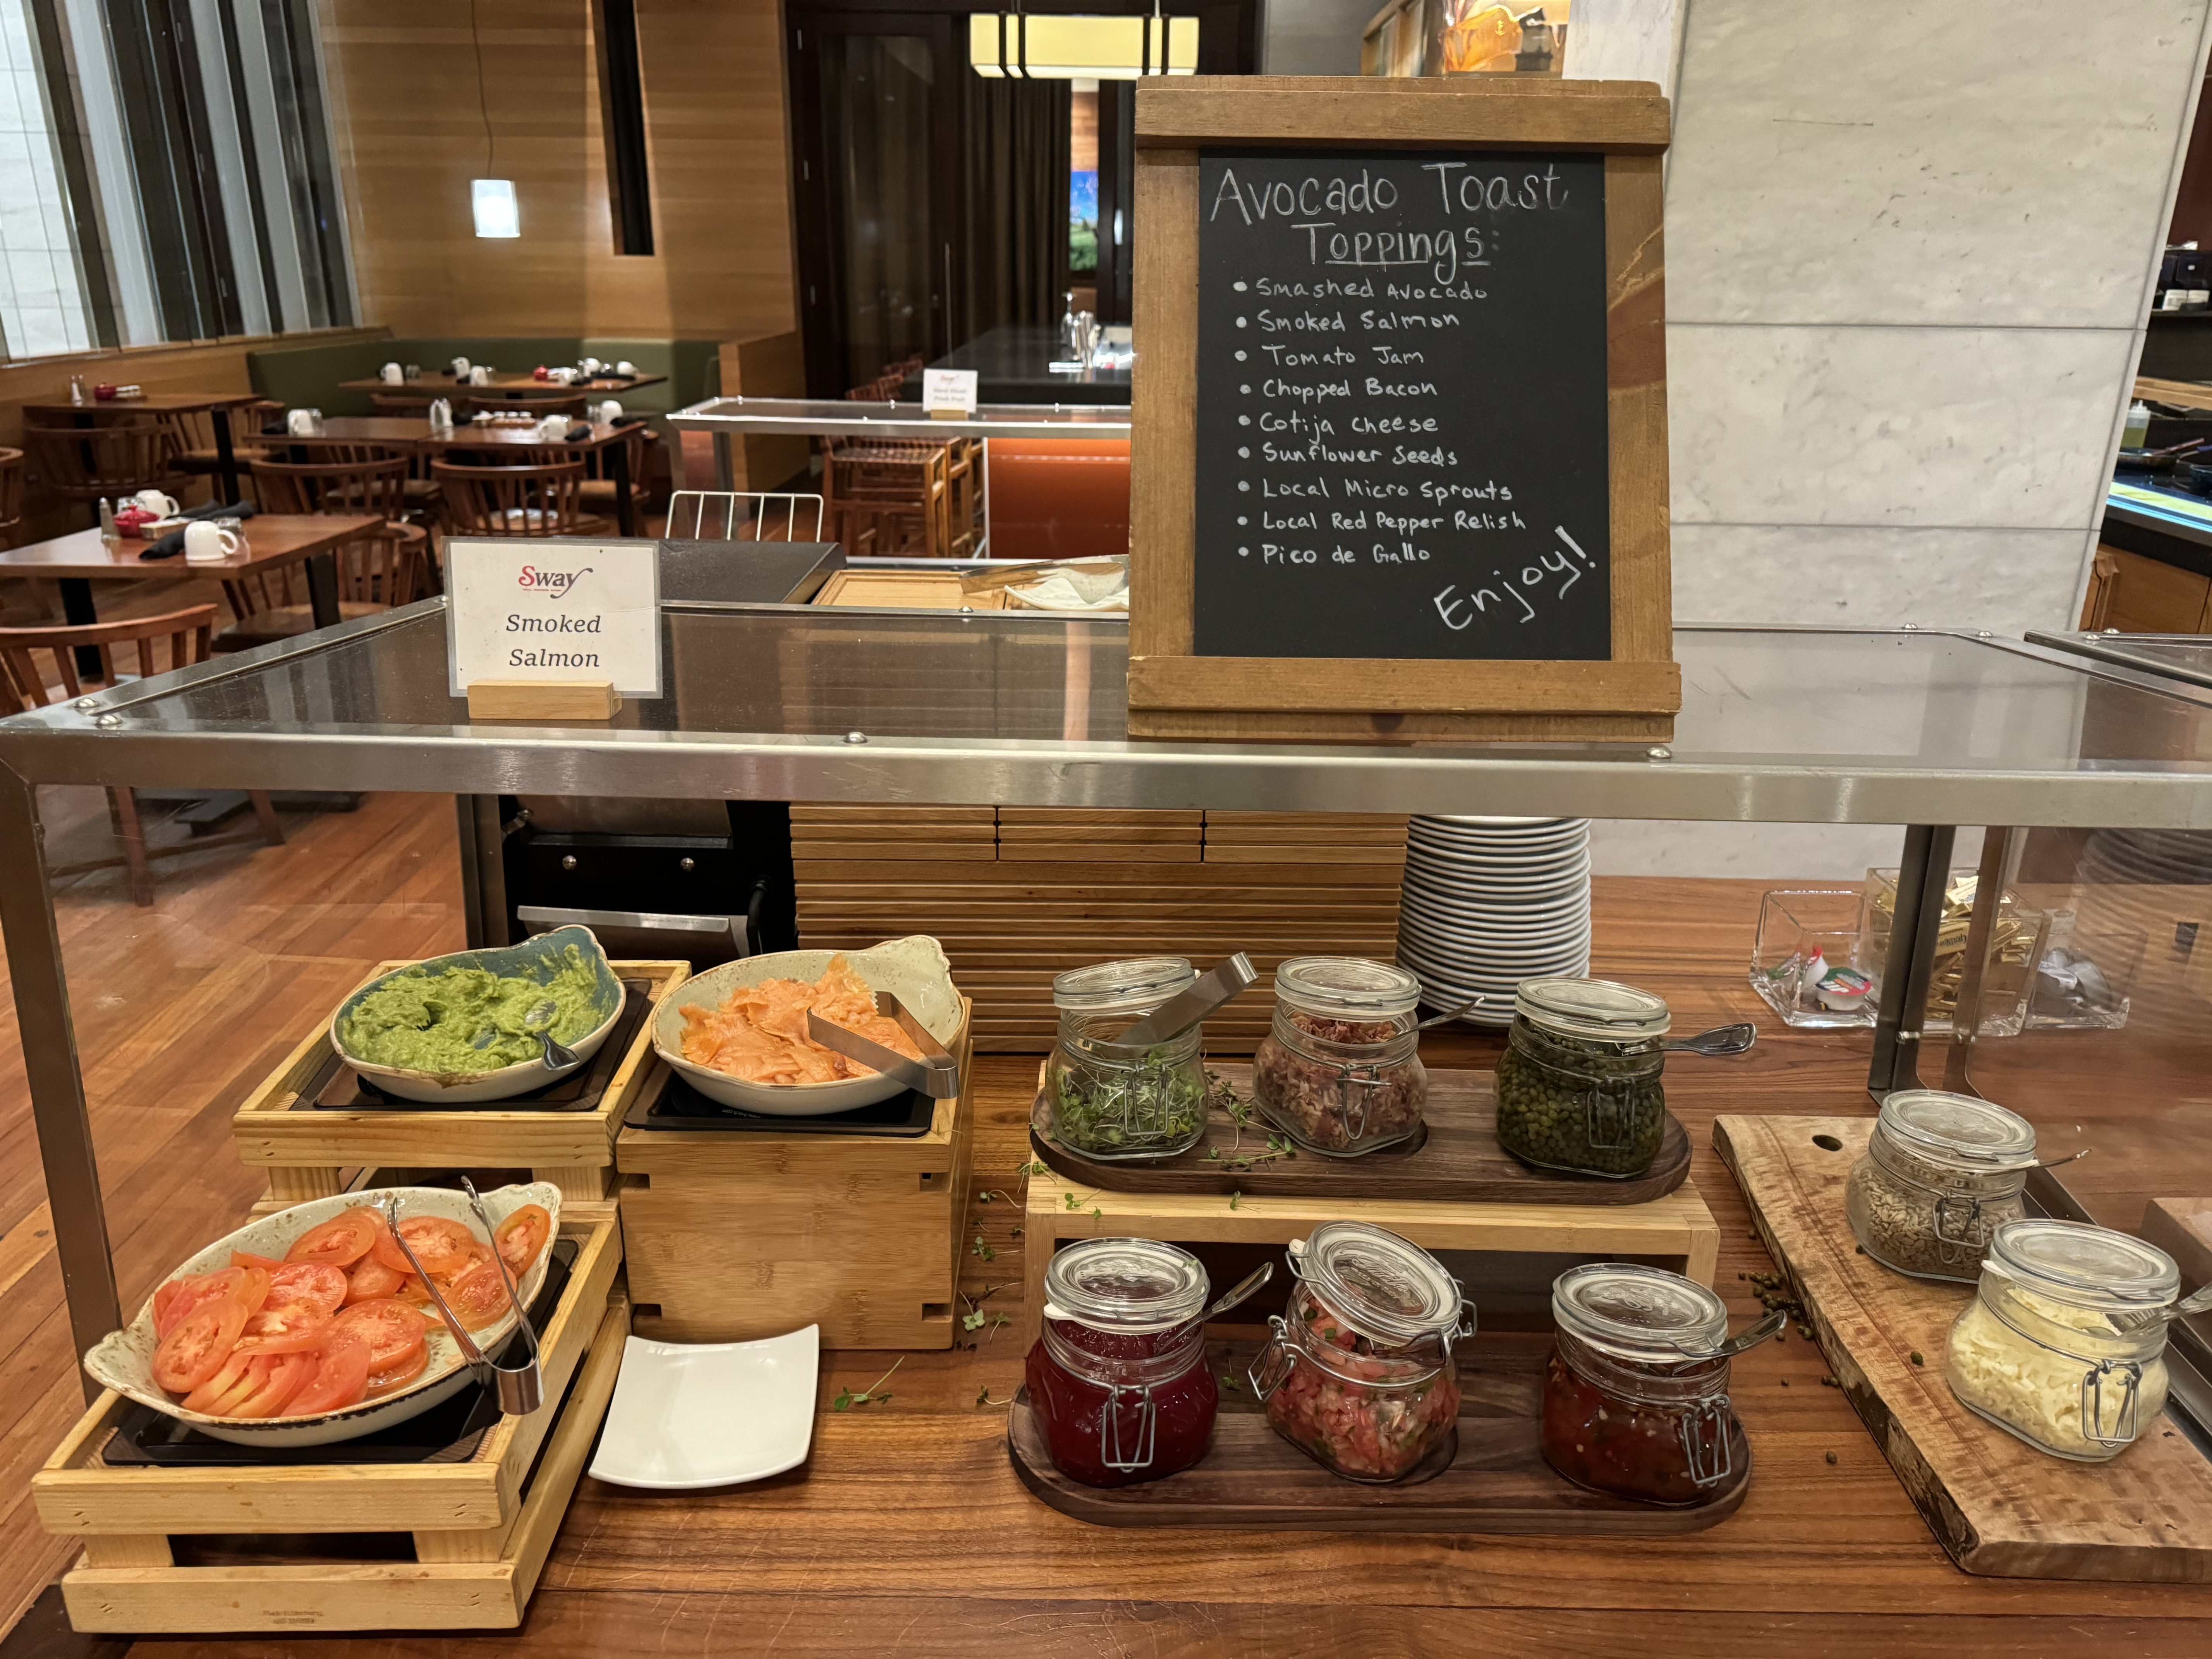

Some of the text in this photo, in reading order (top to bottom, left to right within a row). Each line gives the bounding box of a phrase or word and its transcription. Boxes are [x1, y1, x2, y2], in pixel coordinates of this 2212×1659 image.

[1210, 162, 1568, 226] Avocado Toast
[1255, 277, 1487, 300] Smashed Avocado
[1257, 309, 1460, 332] Smoked Salmon
[1261, 344, 1424, 366] Tomato Jam
[1263, 377, 1438, 405] Chopped Bacon
[1259, 410, 1335, 445] Cotija
[1262, 441, 1458, 467] Sunflower Seeds
[1263, 476, 1513, 507] Local Micro Sprouts
[1263, 510, 1526, 533] Local Red Pepper Relish
[1261, 541, 1431, 565] Pico de Gallo
[518, 565, 594, 599] Sway
[1433, 525, 1596, 630] Enjoy!
[506, 614, 601, 633] Smoked
[509, 649, 600, 667] Salmon
